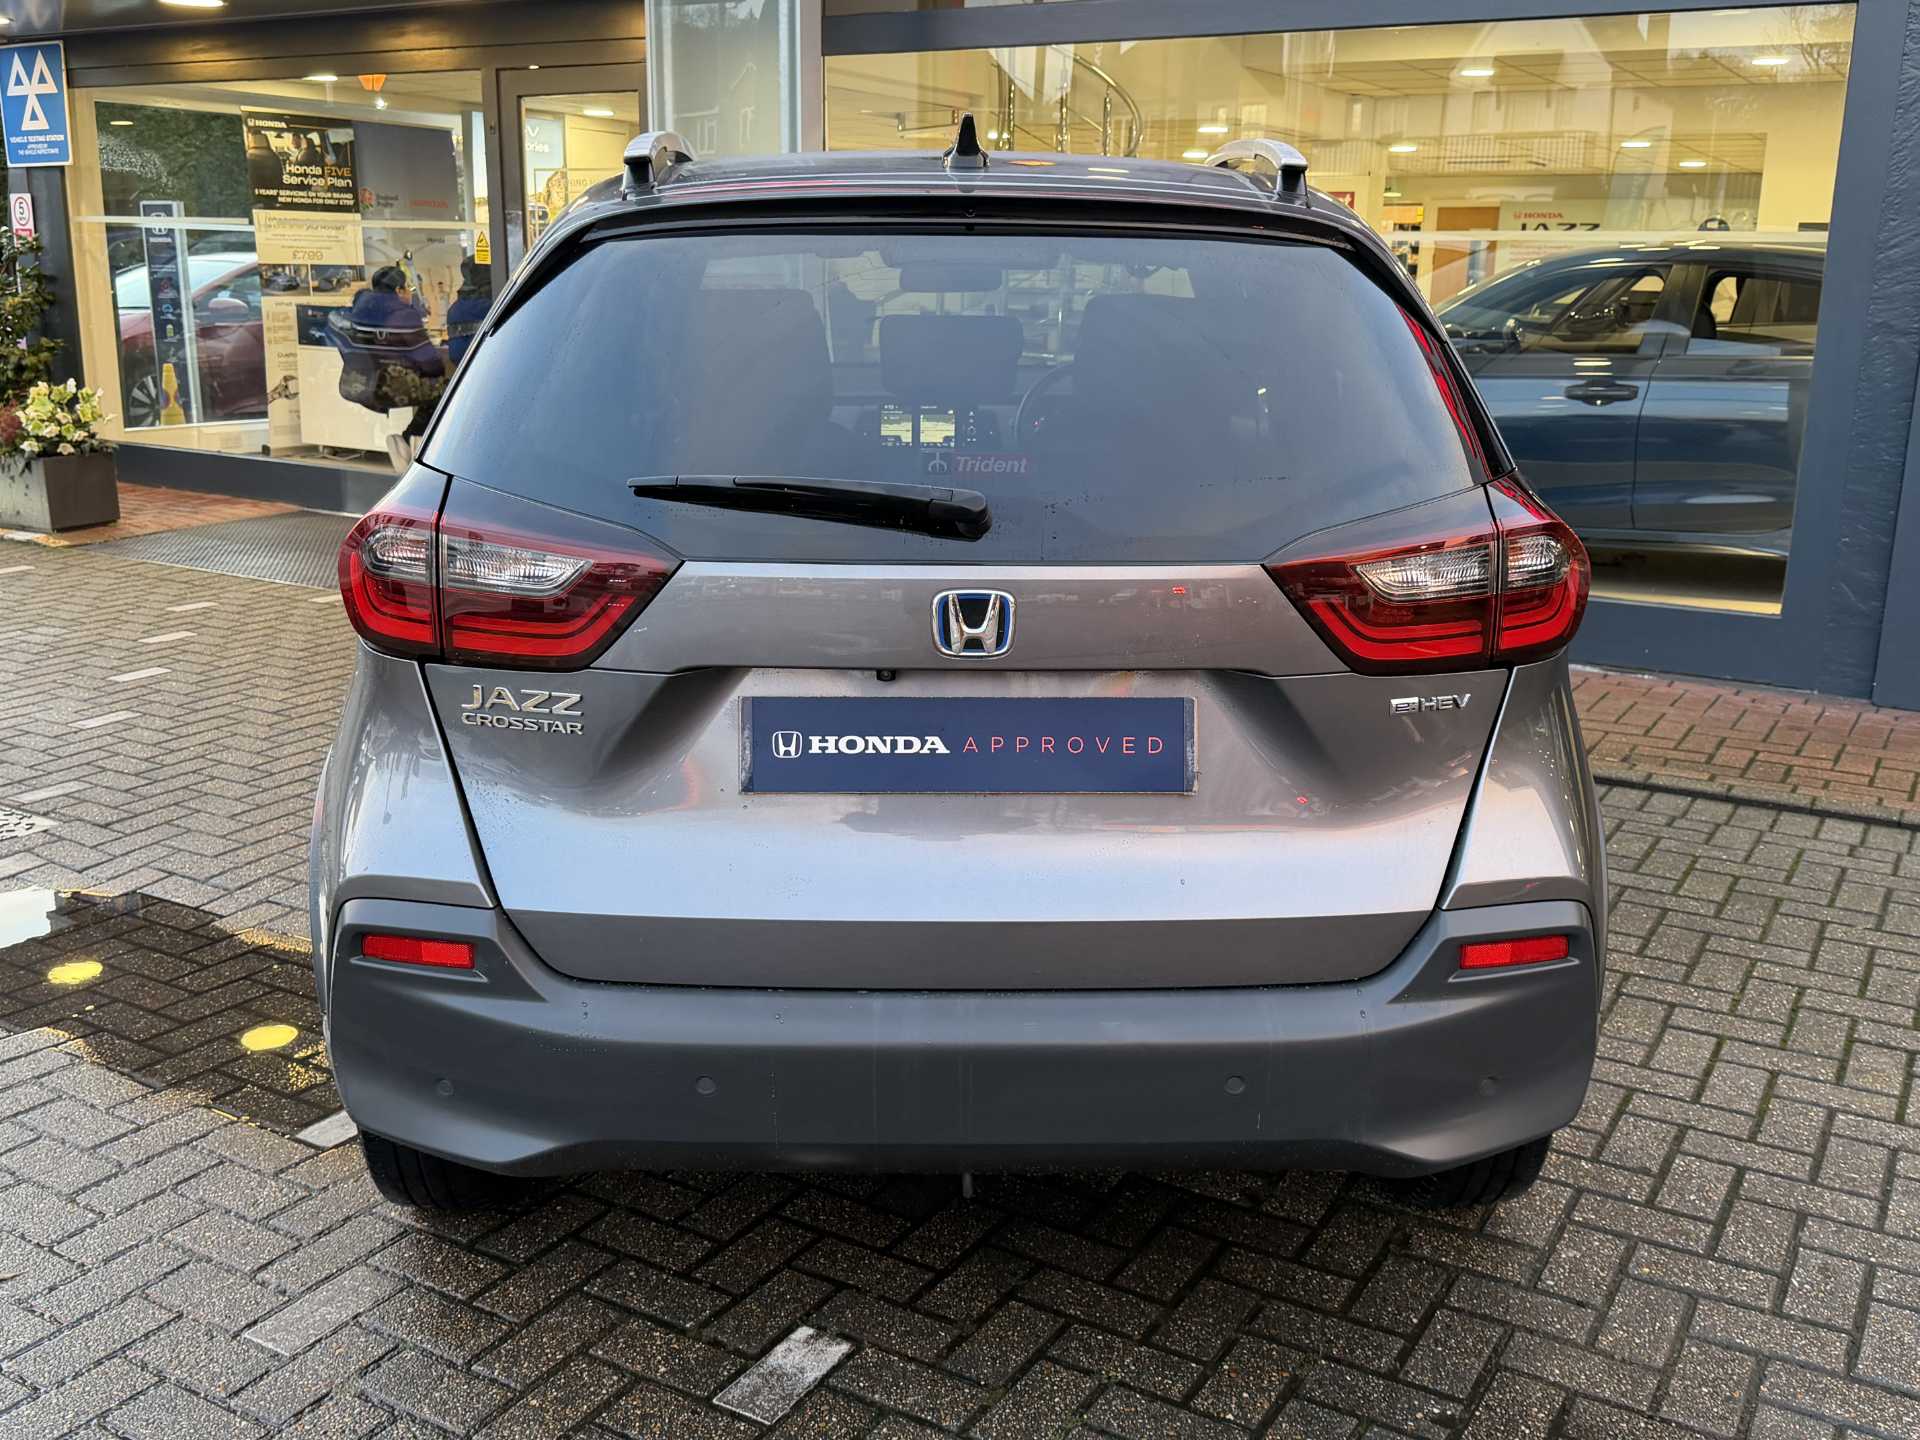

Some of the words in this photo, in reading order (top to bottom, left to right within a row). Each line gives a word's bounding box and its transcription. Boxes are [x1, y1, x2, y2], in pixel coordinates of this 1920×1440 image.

[255, 120, 288, 128] HONDA
[286, 163, 322, 175] Honda
[324, 166, 352, 177] FIVE
[282, 175, 325, 186] Service
[327, 176, 353, 188] Plan
[956, 456, 1028, 473] Trident
[461, 684, 584, 716] JAZZ
[461, 712, 584, 735] CROSSTAR
[808, 735, 951, 754] HONDA
[962, 736, 1164, 754] APPROVED
